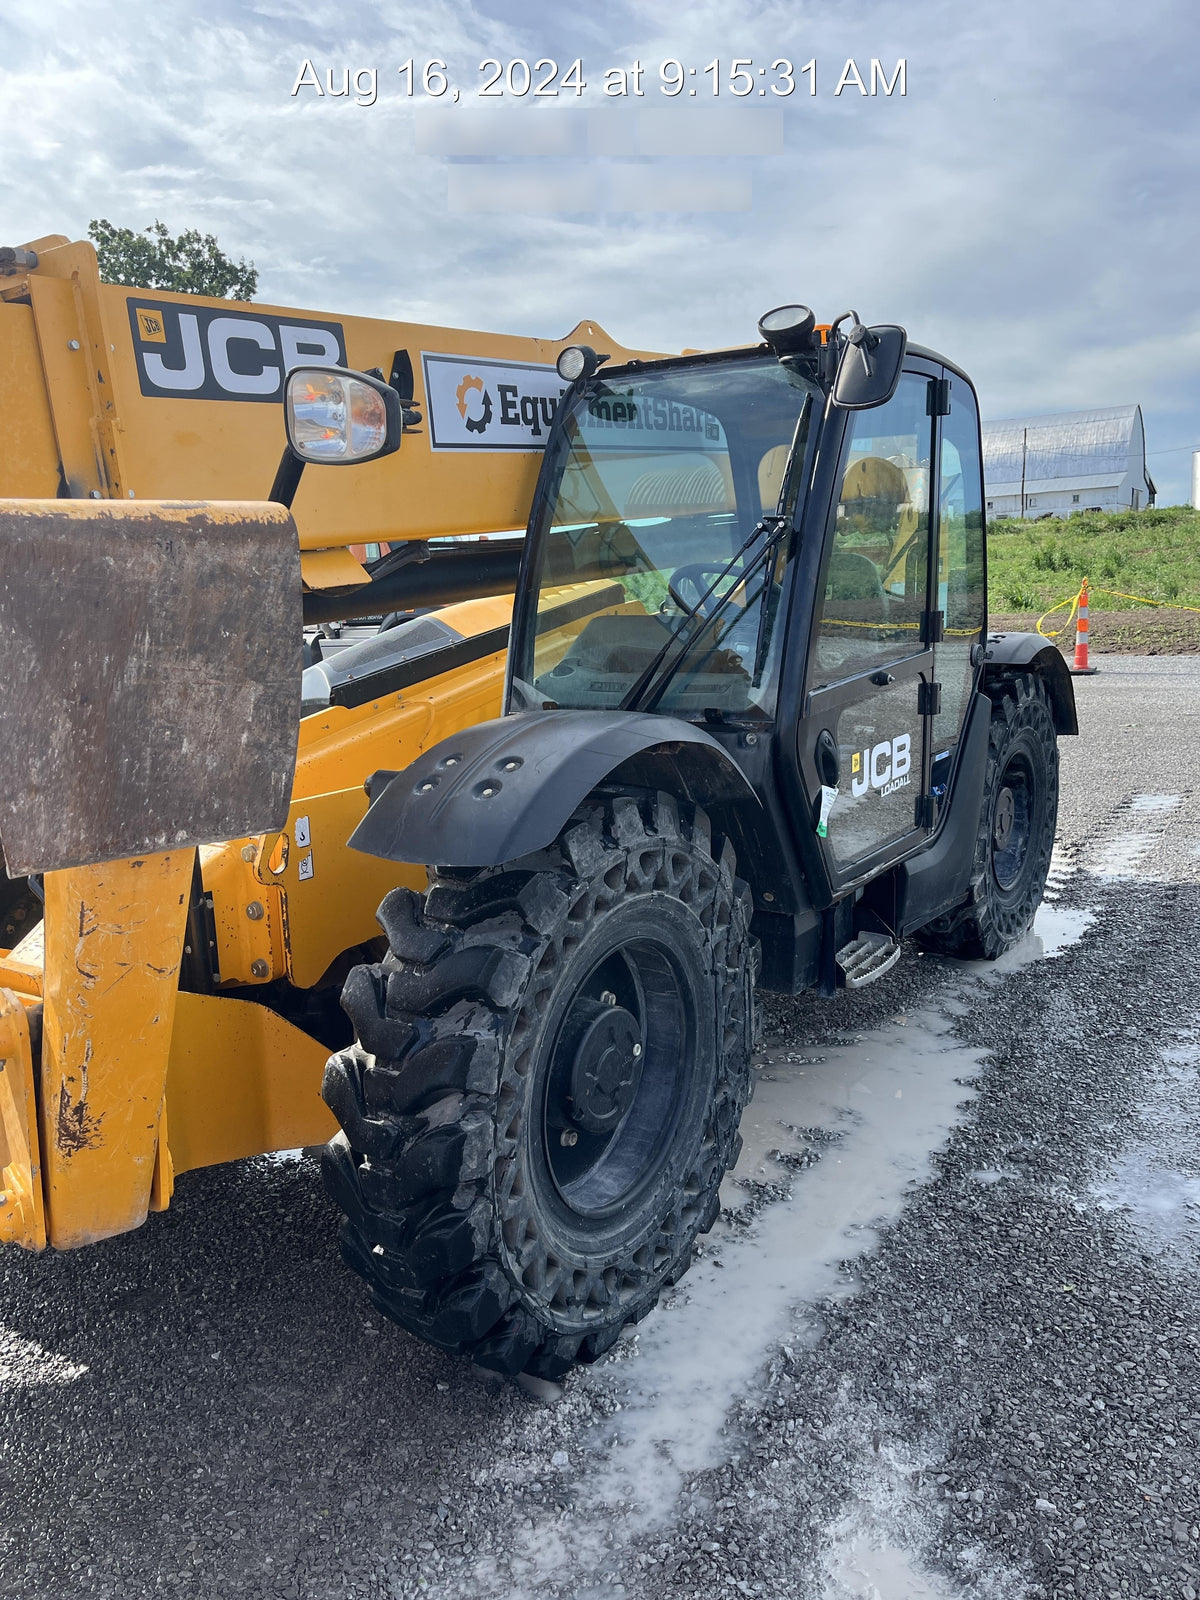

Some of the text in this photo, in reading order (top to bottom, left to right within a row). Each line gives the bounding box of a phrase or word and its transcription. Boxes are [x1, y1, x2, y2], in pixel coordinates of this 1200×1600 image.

[143, 313, 340, 395] JCB
[851, 733, 911, 798] JCB
[880, 773, 911, 798] LOADALL
